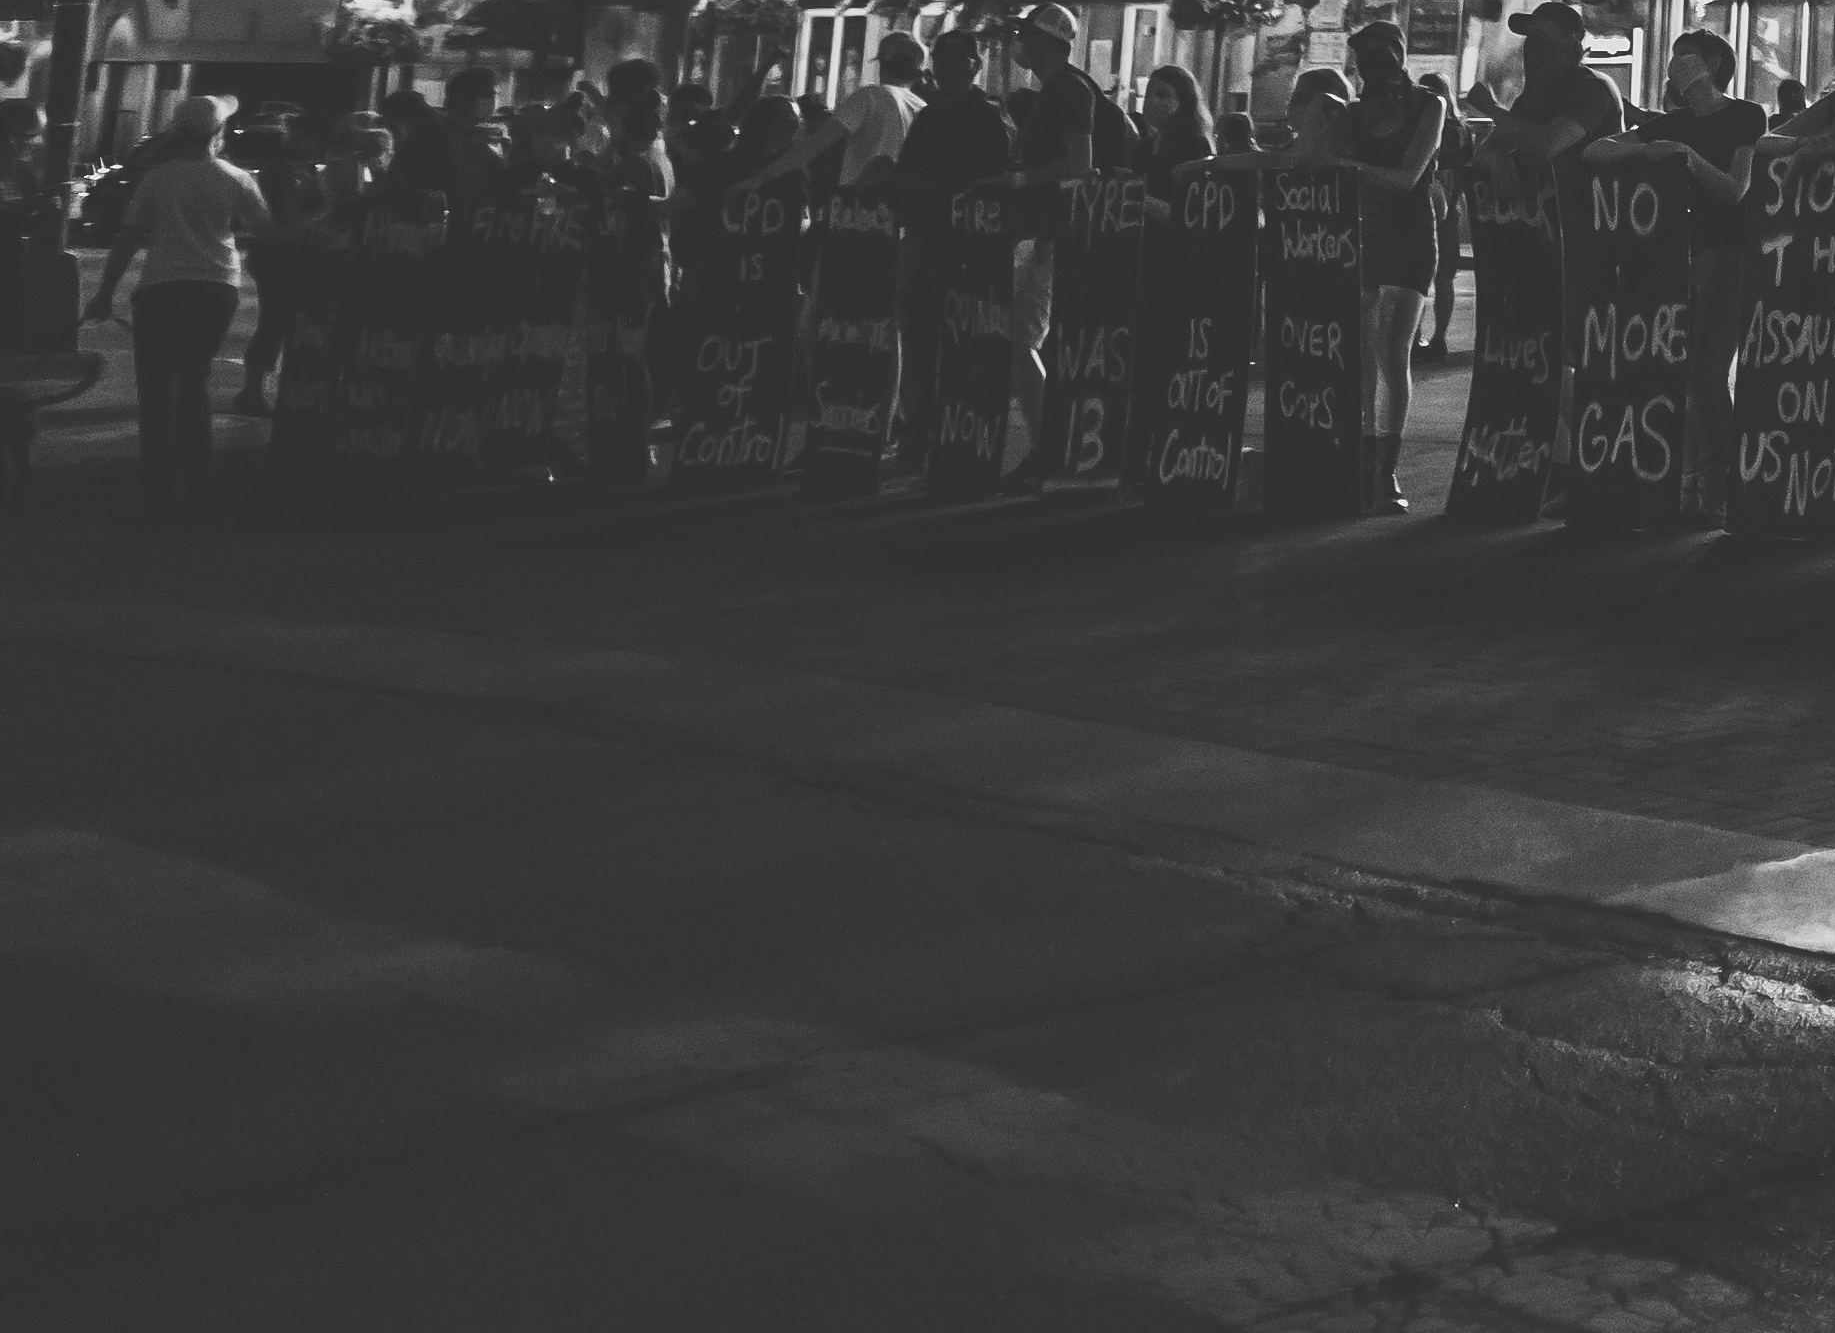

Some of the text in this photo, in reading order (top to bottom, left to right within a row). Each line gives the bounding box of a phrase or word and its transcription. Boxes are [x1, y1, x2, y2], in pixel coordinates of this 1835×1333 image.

[721, 190, 787, 235] CPD
[1059, 179, 1145, 233] TYRE
[1184, 182, 1235, 231] CPD
[1275, 173, 1340, 214] Social
[1591, 176, 1659, 236] NO
[1280, 225, 1358, 268] Workers
[1056, 323, 1132, 382] WAS
[1187, 317, 1213, 360] IS
[1280, 316, 1346, 372] OVER
[1479, 325, 1552, 385] Lives
[1581, 303, 1688, 380] MORE
[1776, 380, 1829, 427] ON
[1158, 427, 1233, 492] Control
[1460, 416, 1551, 488] Matter
[1578, 396, 1676, 483] GAS
[1738, 430, 1790, 484] US
